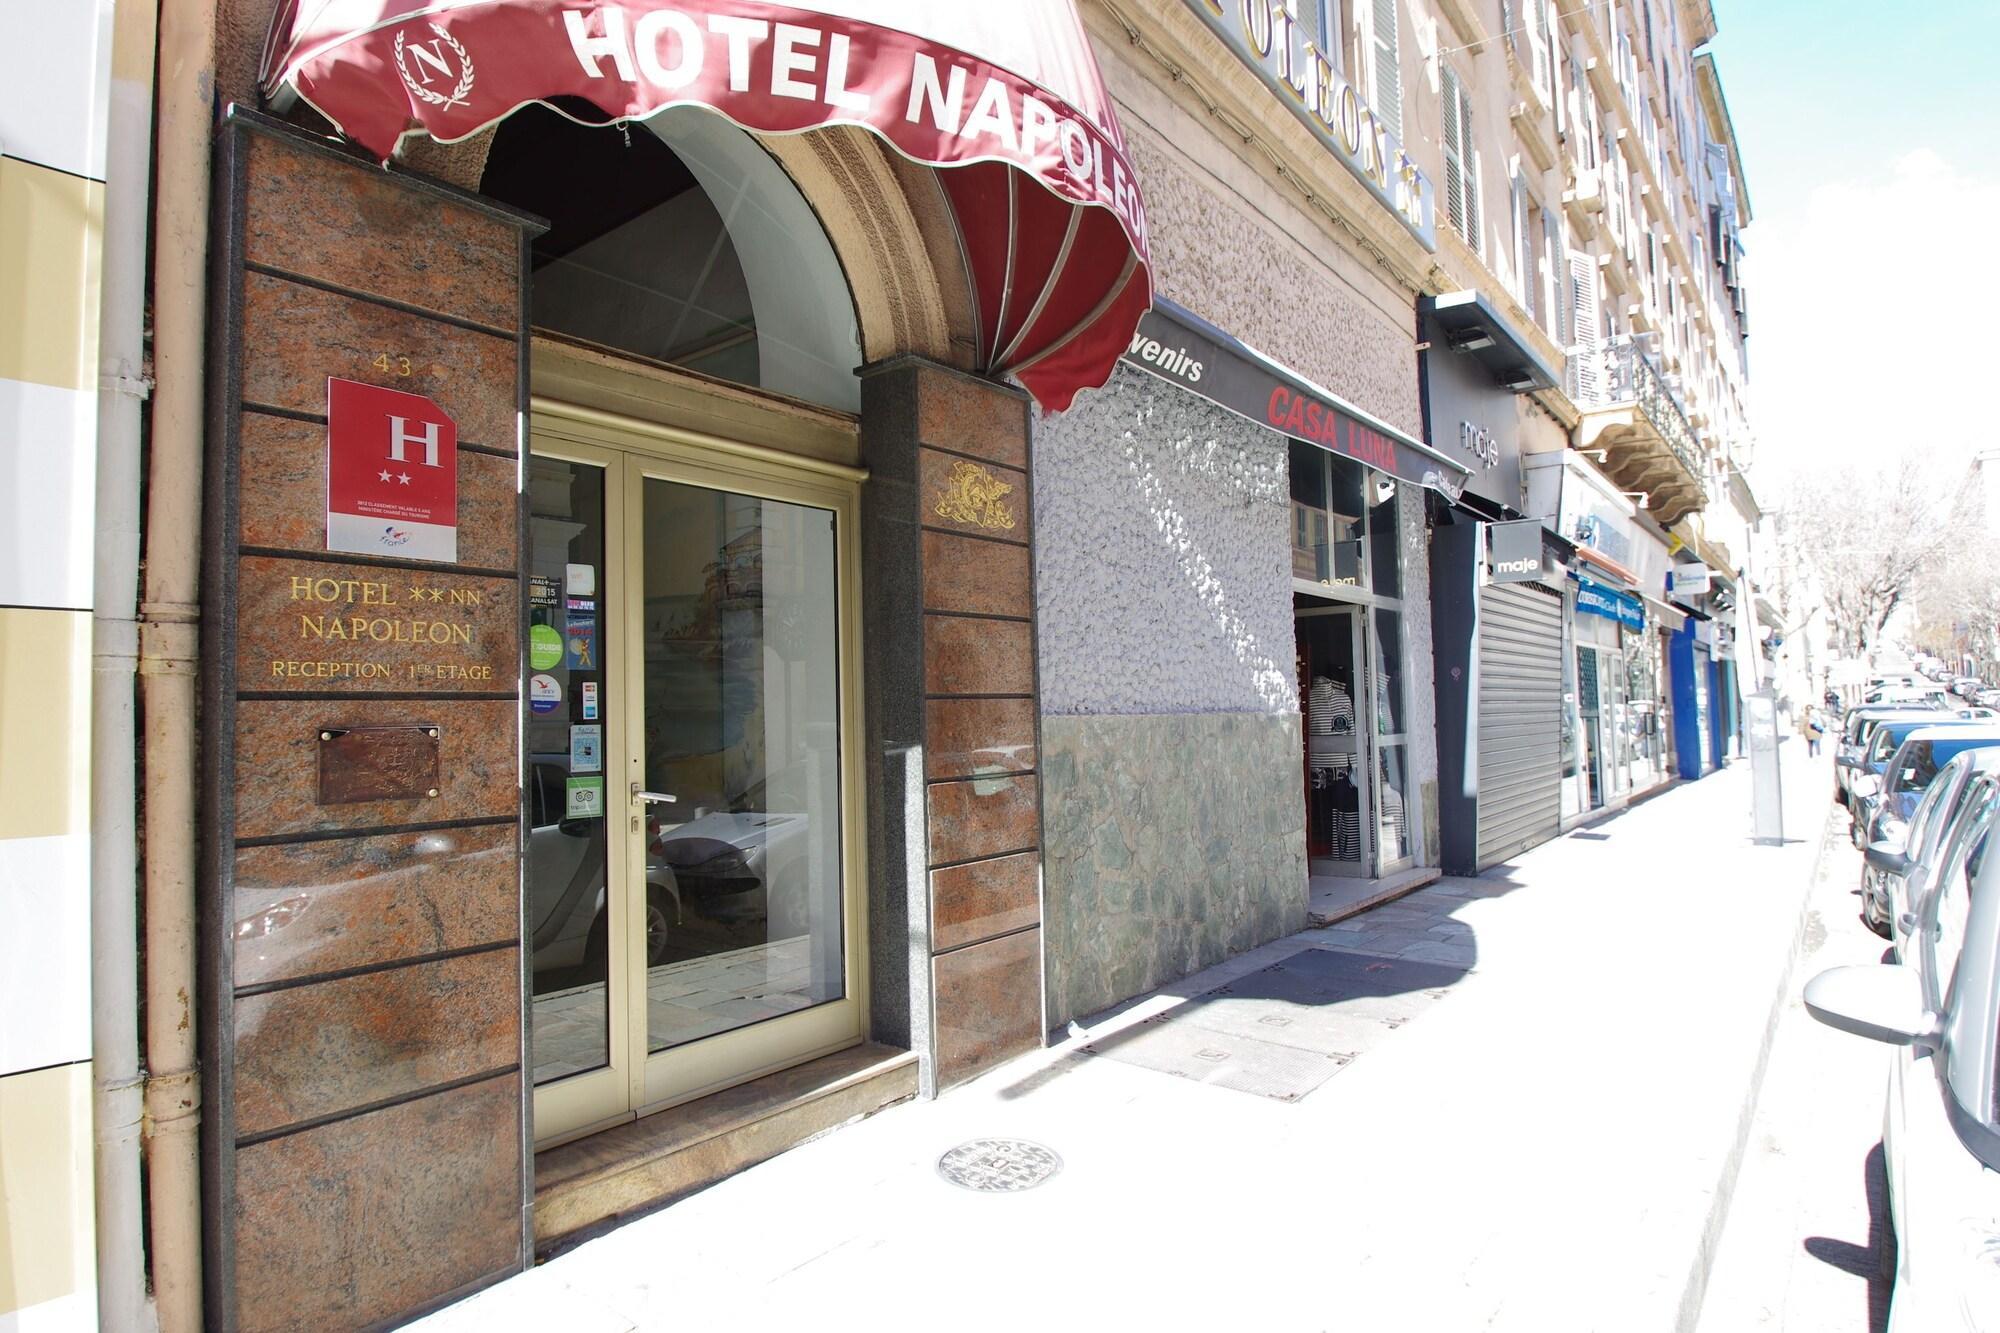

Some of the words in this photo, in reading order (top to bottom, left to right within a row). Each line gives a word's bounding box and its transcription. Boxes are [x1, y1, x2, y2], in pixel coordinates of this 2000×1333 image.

[562, 9, 871, 112] HOTEL
[1202, 0, 1387, 190] OLEON
[385, 414, 444, 468] H
[1267, 386, 1338, 450] CASA
[1348, 419, 1397, 473] LUNA
[1463, 419, 1498, 470] maje
[290, 576, 396, 605] HOTEL
[1497, 558, 1538, 574] maje
[301, 615, 471, 645] NAPOLEON
[271, 661, 391, 678] RECEPTION
[436, 666, 492, 680] ETAGE
